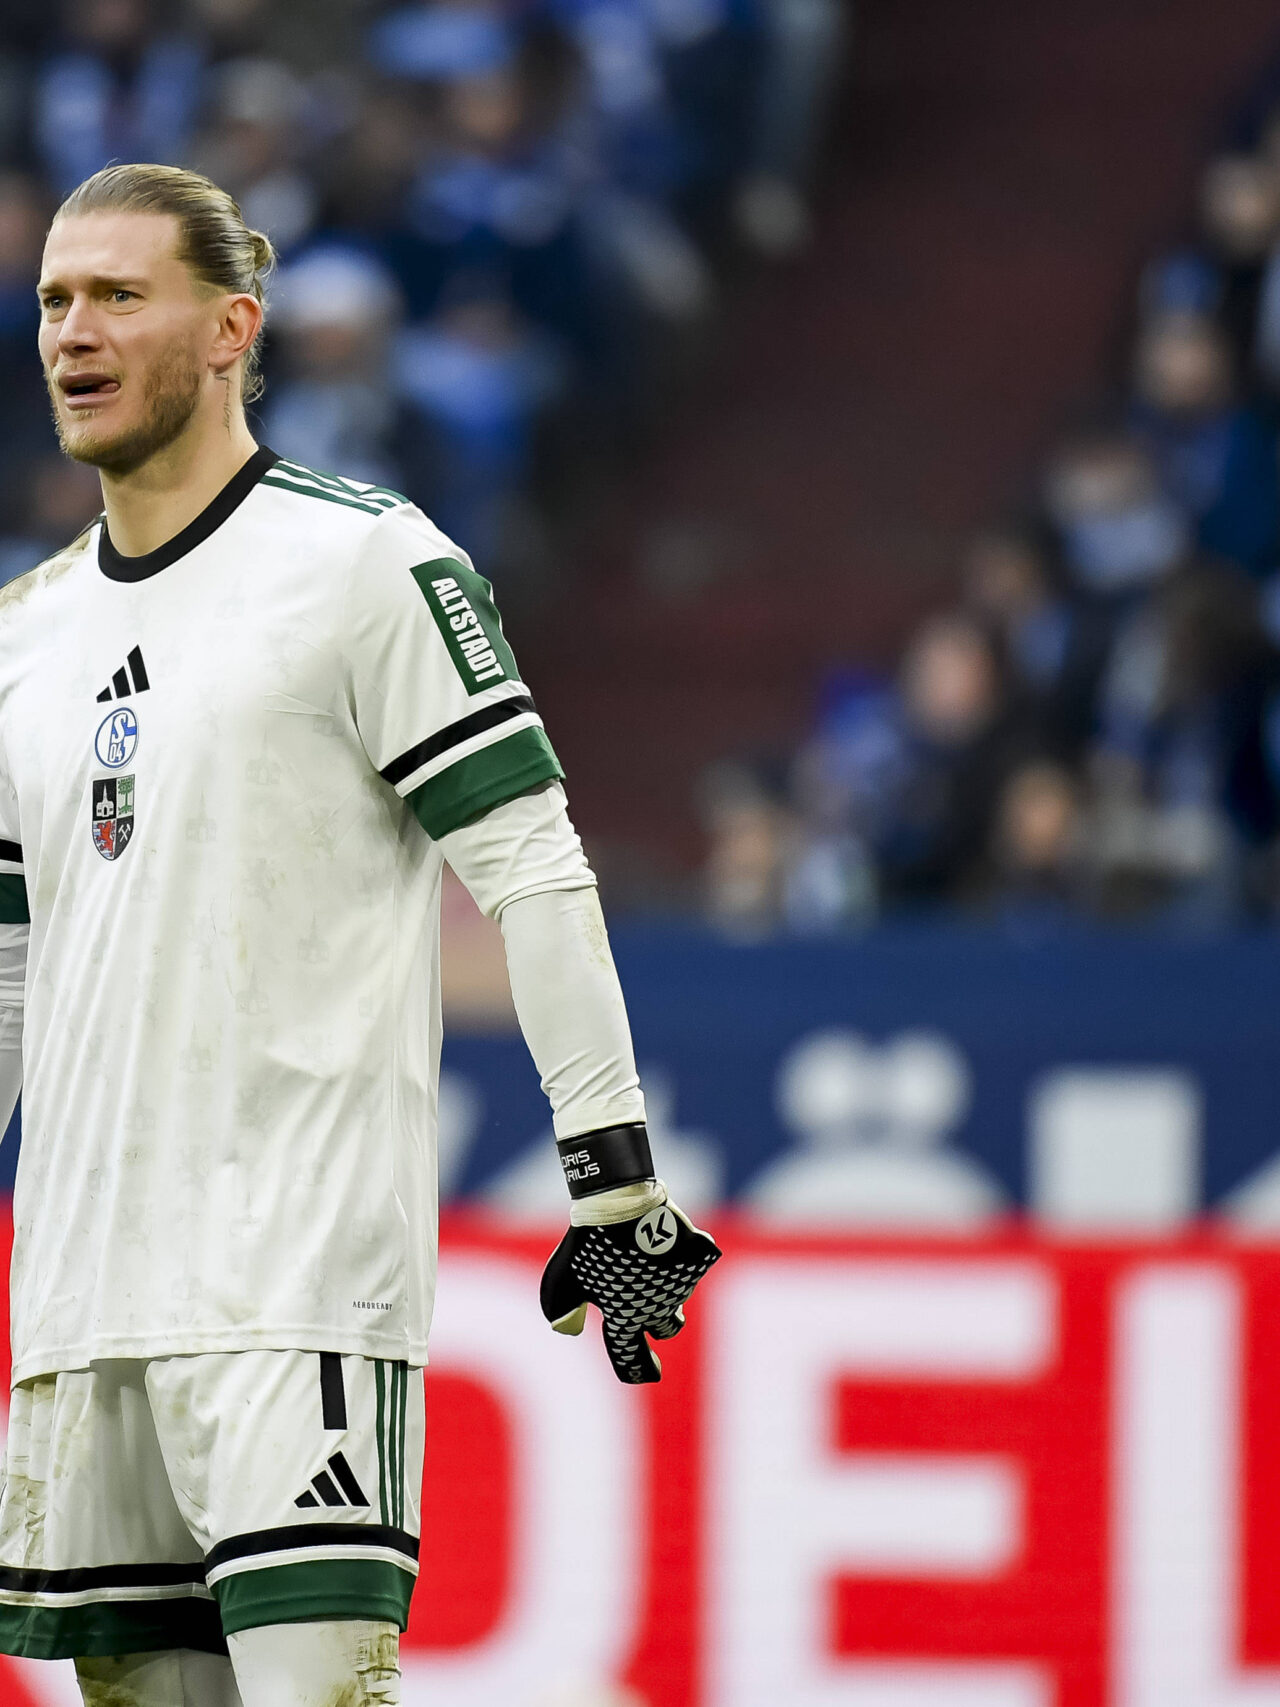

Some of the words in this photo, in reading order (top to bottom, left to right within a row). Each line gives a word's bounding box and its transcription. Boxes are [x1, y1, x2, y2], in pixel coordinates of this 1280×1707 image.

[430, 576, 505, 683] ALTSTADT
[560, 1149, 591, 1168] ORIS
[565, 1162, 601, 1183] RIUS
